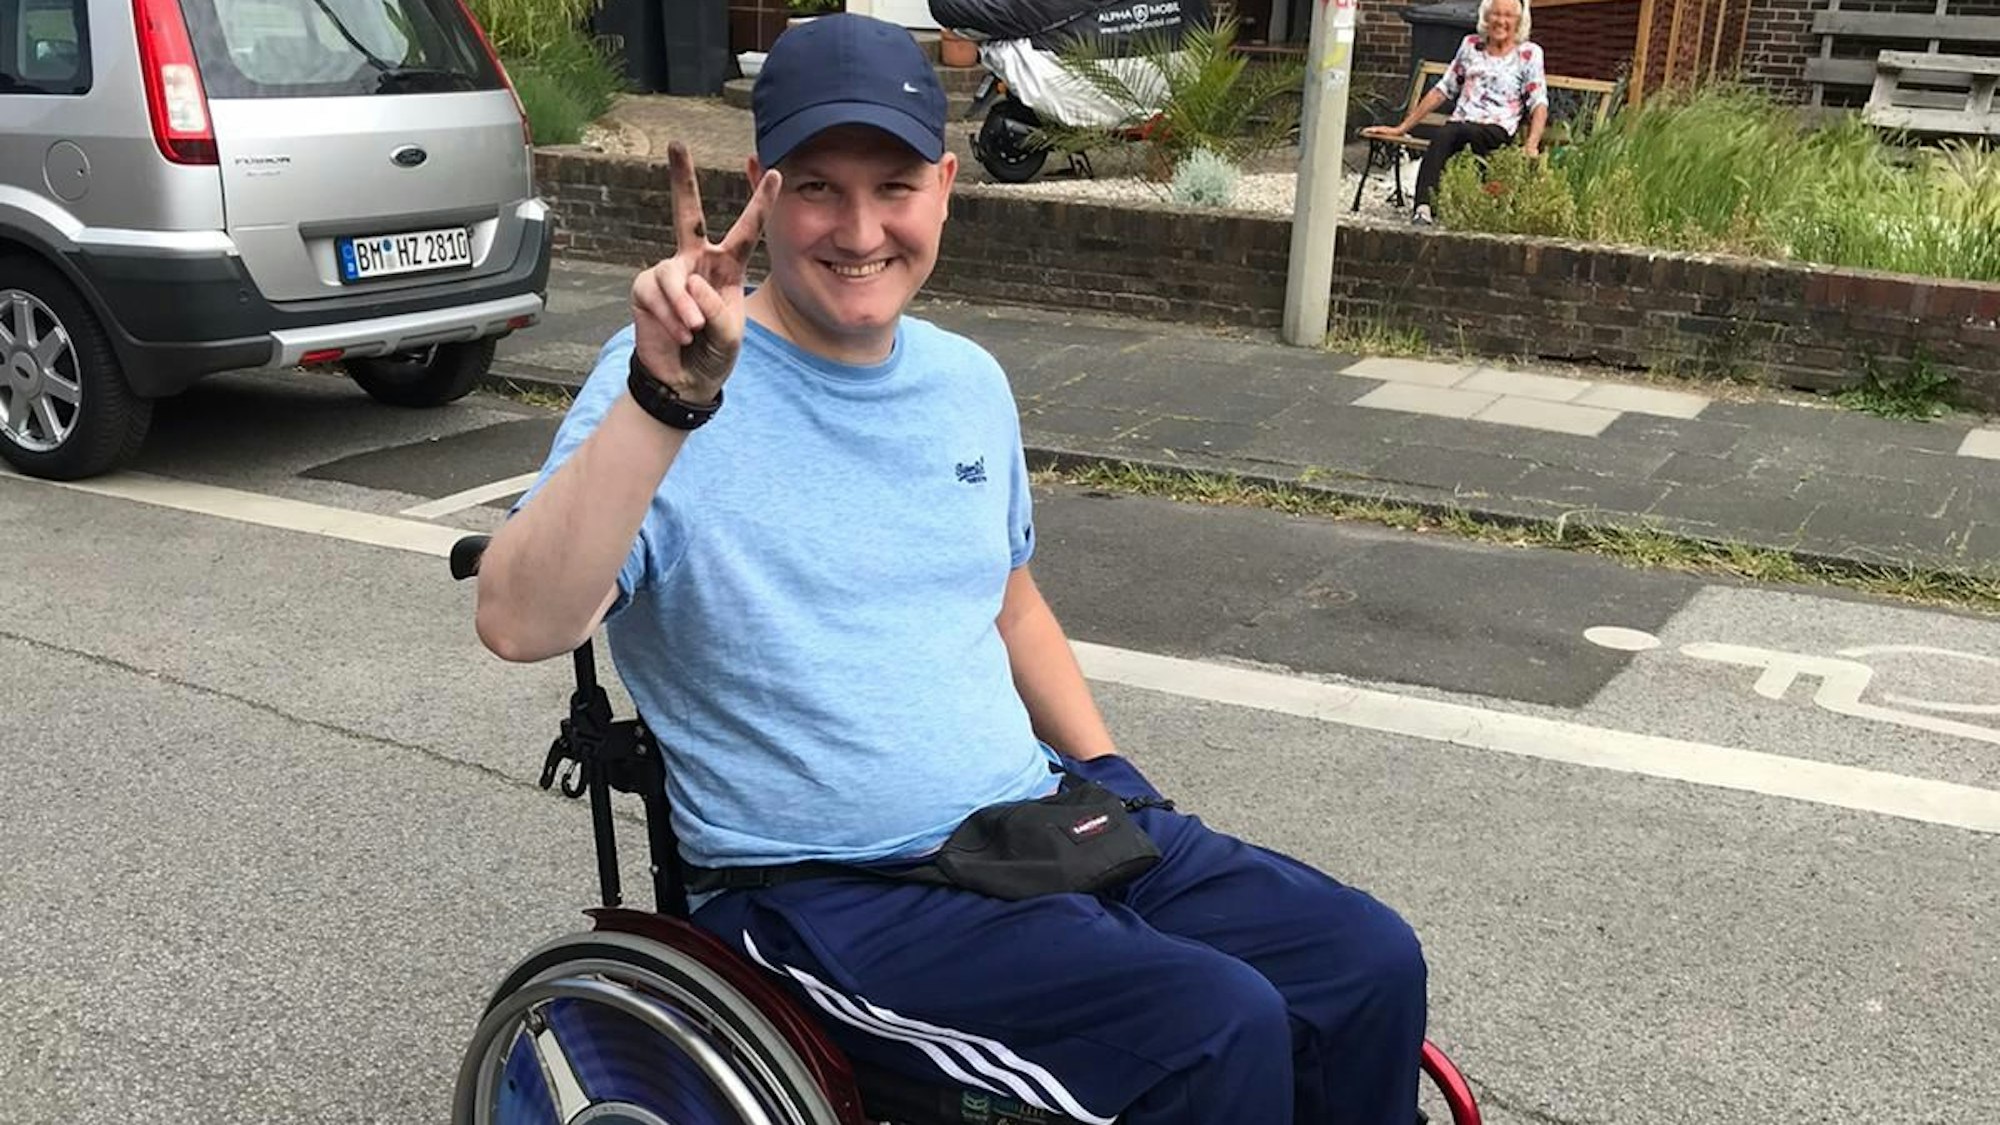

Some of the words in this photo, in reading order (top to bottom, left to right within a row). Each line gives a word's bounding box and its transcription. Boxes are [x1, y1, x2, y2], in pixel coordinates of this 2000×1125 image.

[1098, 9, 1132, 23] ALPHA
[1149, 2, 1181, 15] MOBIL
[357, 241, 384, 272] BM
[396, 238, 422, 267] HZ
[425, 231, 468, 262] 2810
